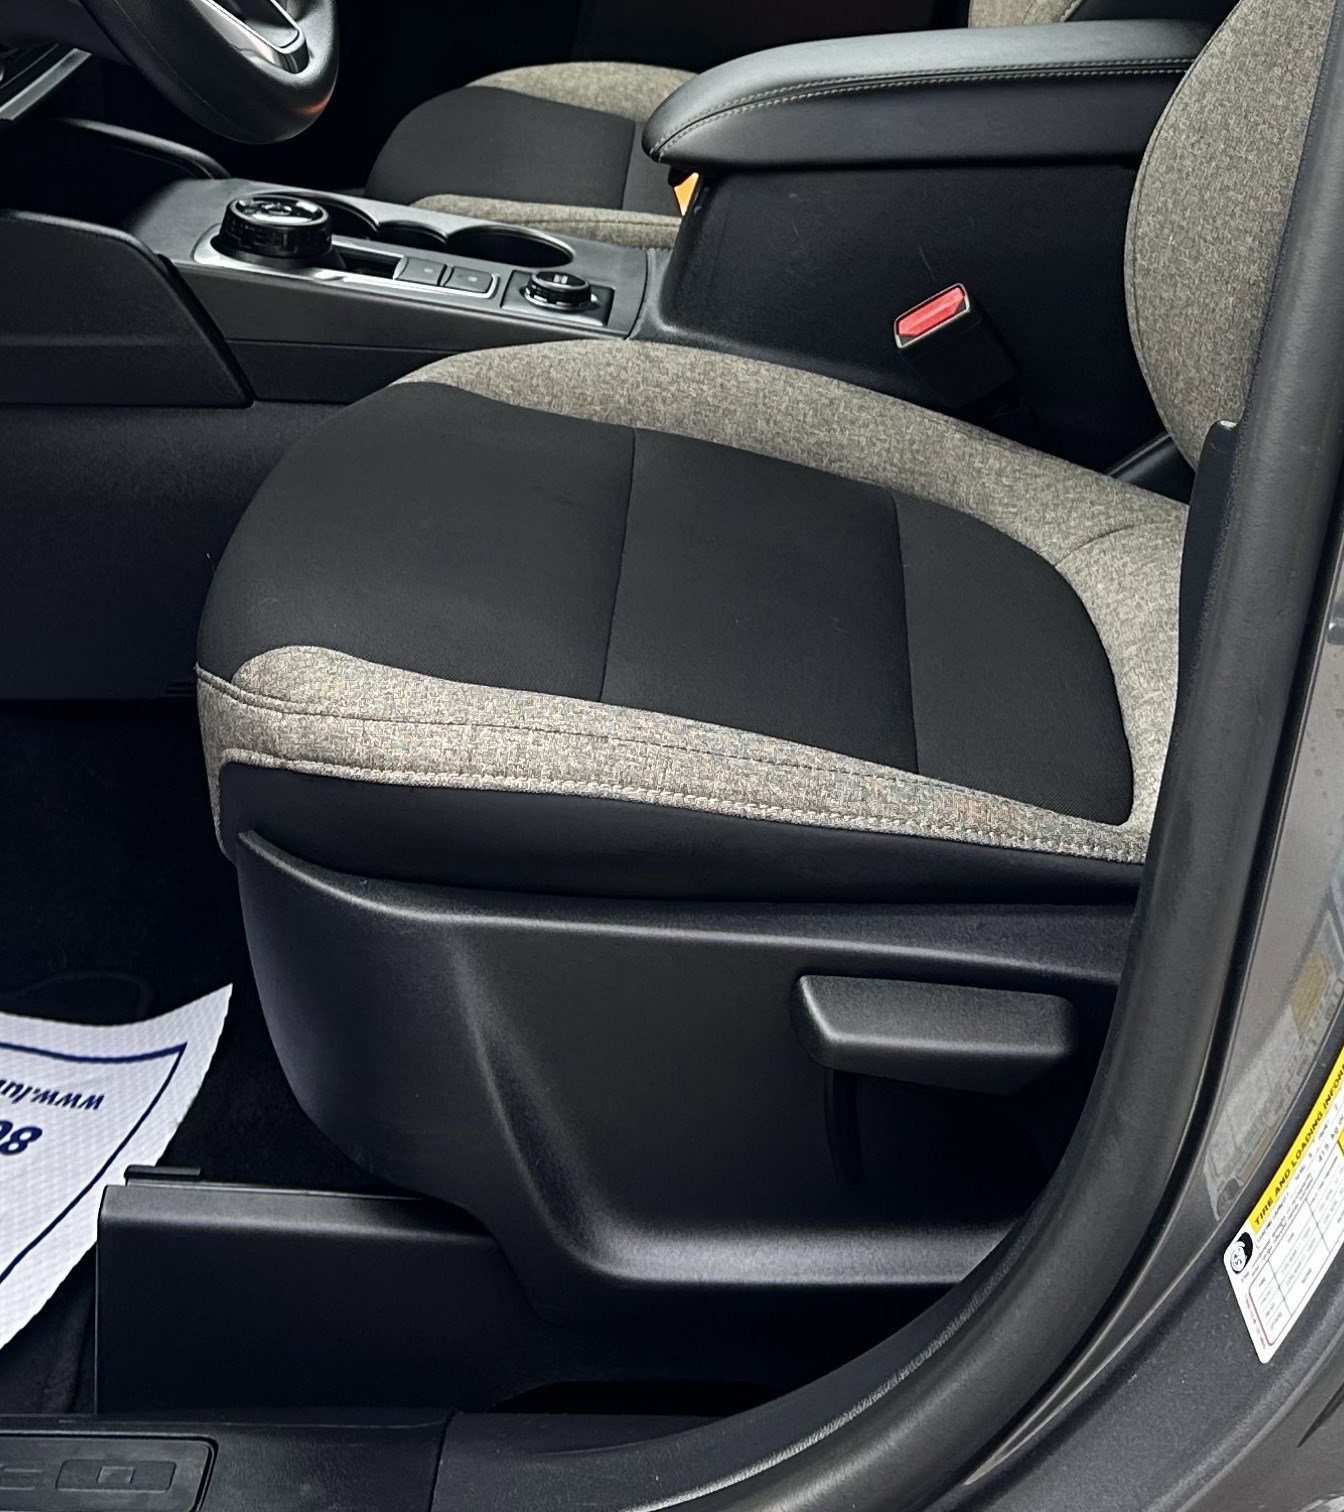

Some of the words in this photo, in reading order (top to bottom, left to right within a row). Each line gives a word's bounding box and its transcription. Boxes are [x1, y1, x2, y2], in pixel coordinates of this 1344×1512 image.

[1254, 1193, 1273, 1228] TIRE
[1273, 1165, 1290, 1197] AND
[1290, 1108, 1323, 1168] LOADING
